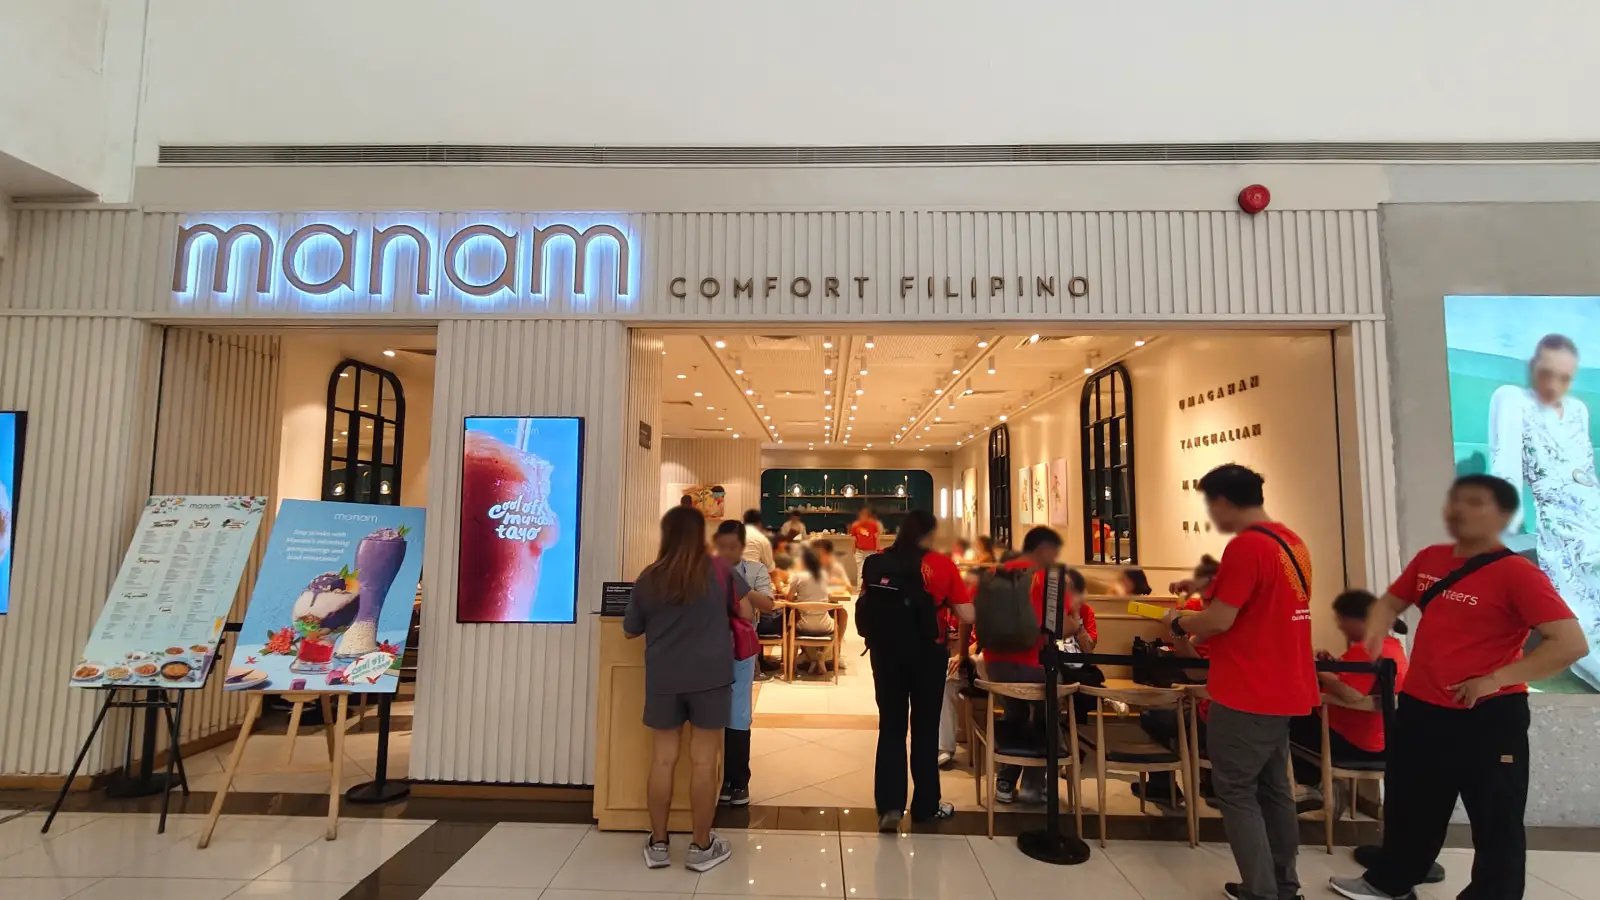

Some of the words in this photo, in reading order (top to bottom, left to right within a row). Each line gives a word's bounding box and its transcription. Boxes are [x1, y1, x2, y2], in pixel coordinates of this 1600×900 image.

[172, 224, 629, 296] manam
[669, 276, 869, 299] COMFORT
[900, 276, 1090, 298] FILIPINO
[1178, 375, 1260, 411] UMAGAHAN
[1179, 423, 1262, 451] TANGHALIAN
[334, 513, 378, 523] manam
[495, 524, 541, 542] tayo
